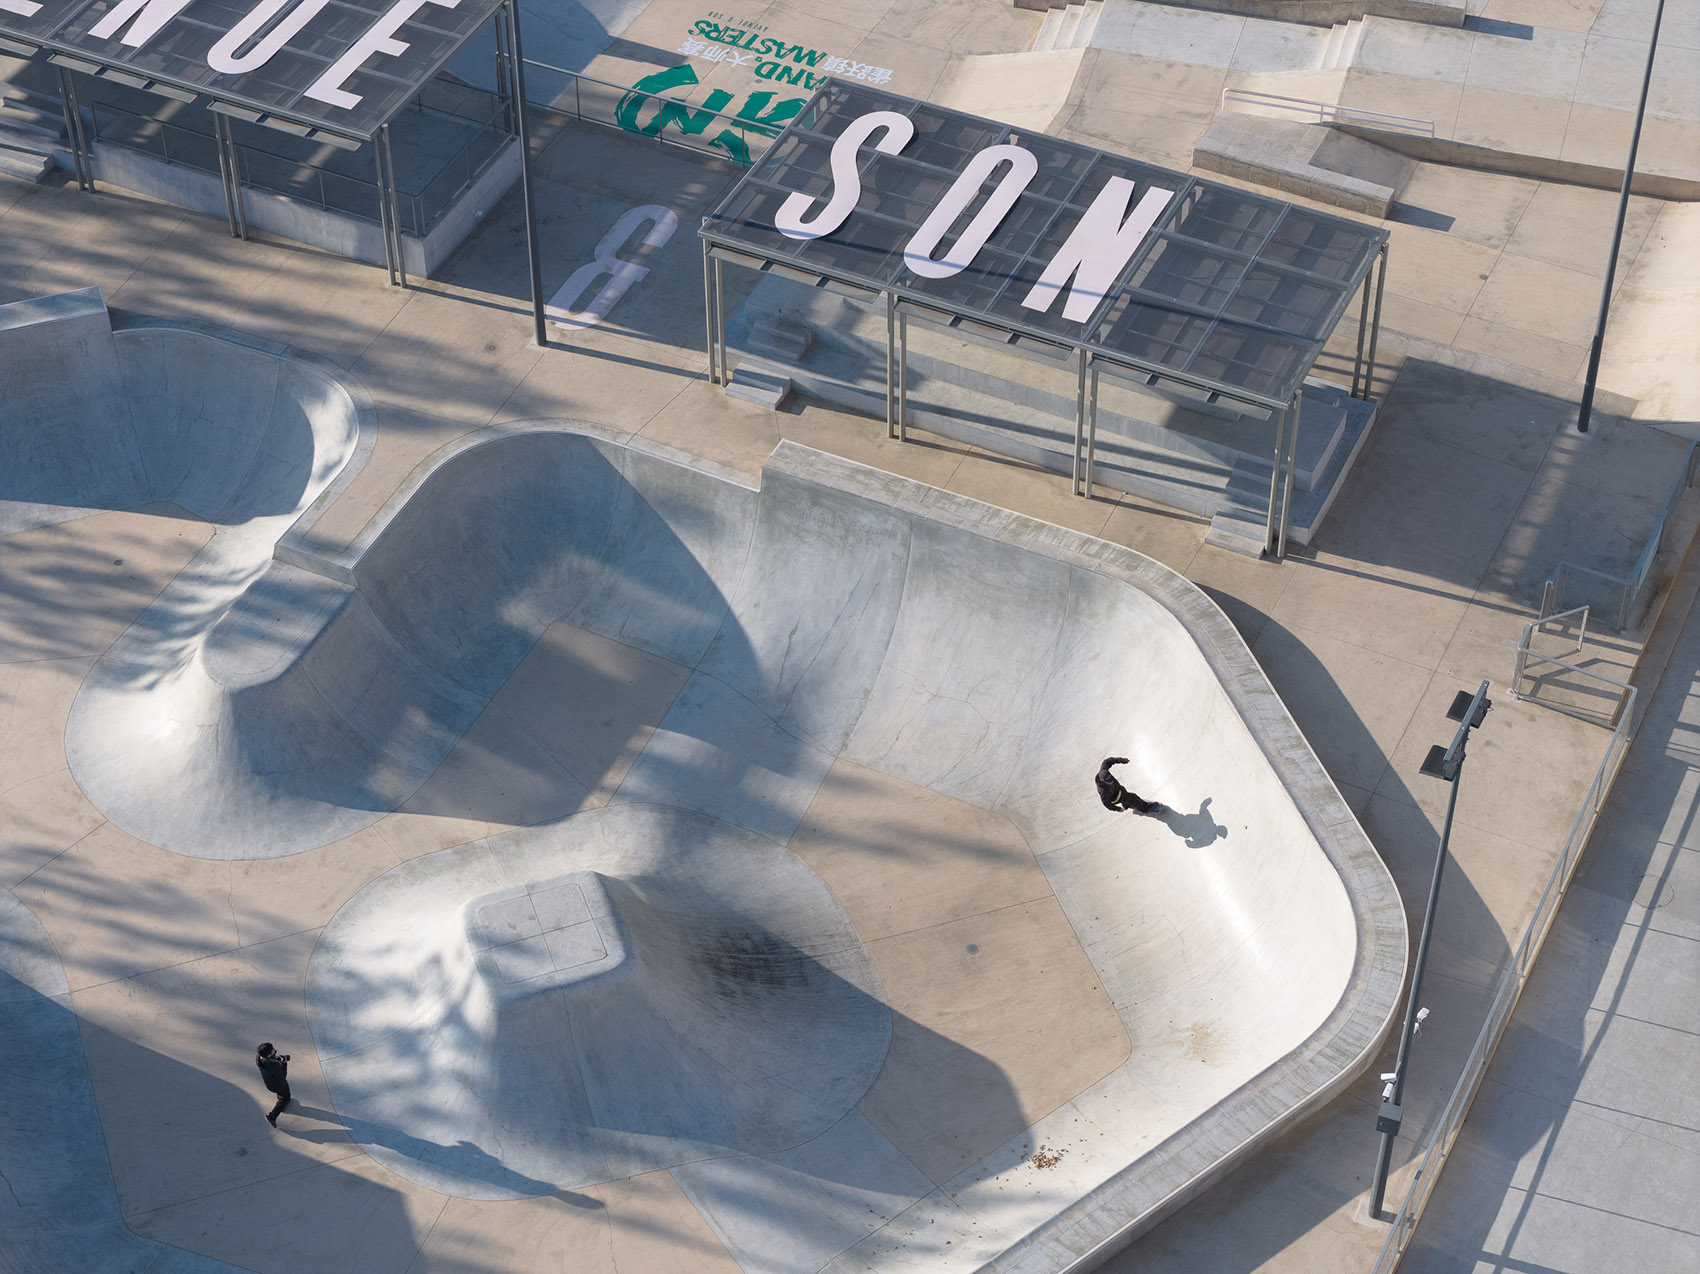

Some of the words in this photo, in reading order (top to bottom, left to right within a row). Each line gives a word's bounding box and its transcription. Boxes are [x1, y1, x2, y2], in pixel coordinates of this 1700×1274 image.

[707, 11, 724, 20] SON
[738, 19, 769, 32] AVENUE
[677, 37, 754, 68] 大师赛
[688, 20, 827, 67] MASTERS
[774, 110, 1174, 323] SON
